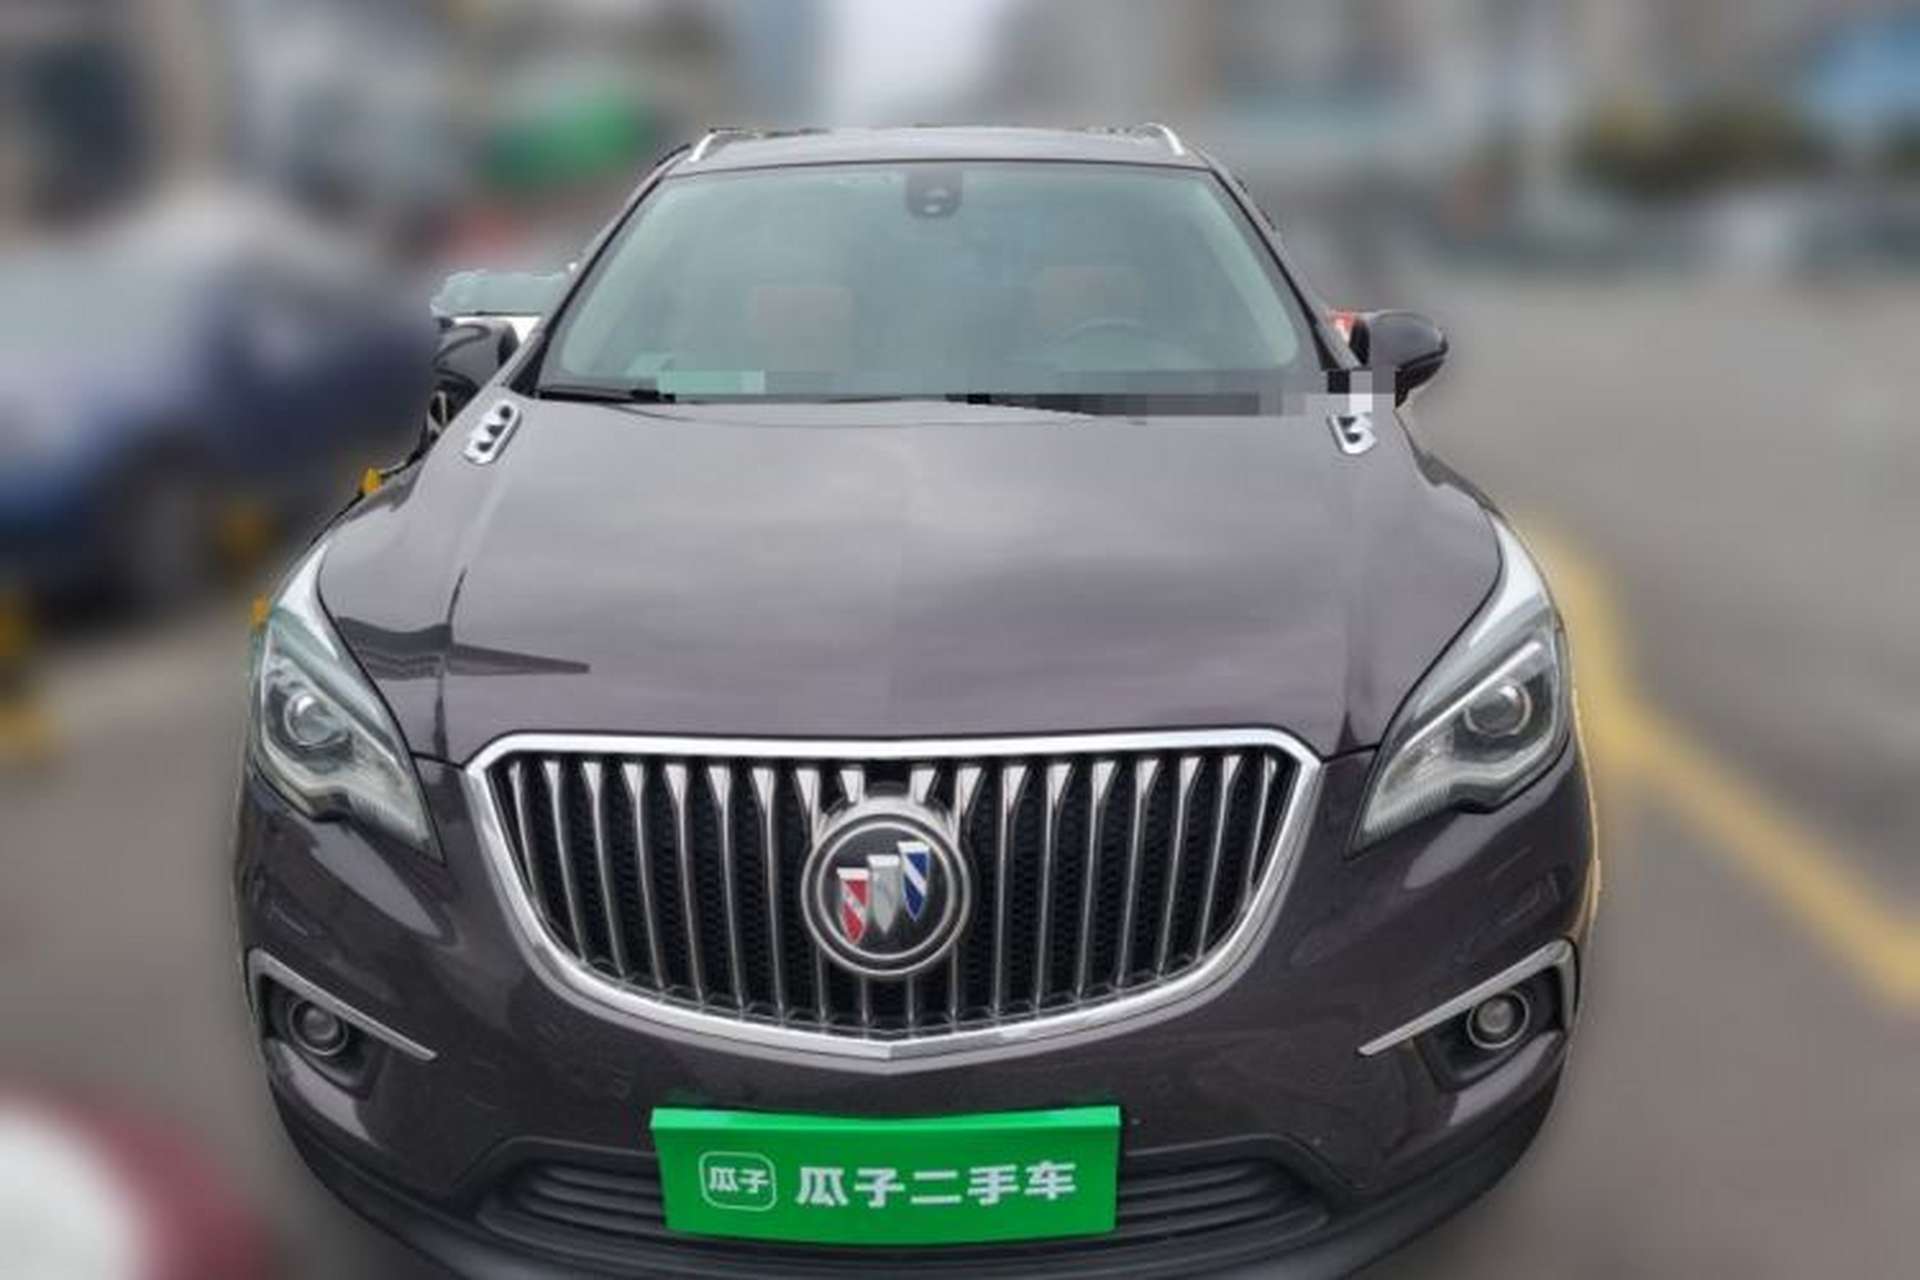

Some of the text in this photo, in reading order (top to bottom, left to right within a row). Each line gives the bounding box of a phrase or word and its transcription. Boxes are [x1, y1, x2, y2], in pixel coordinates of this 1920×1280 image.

[708, 1166, 770, 1197] 瓜子
[796, 1160, 1077, 1208] 瓜子二手车
